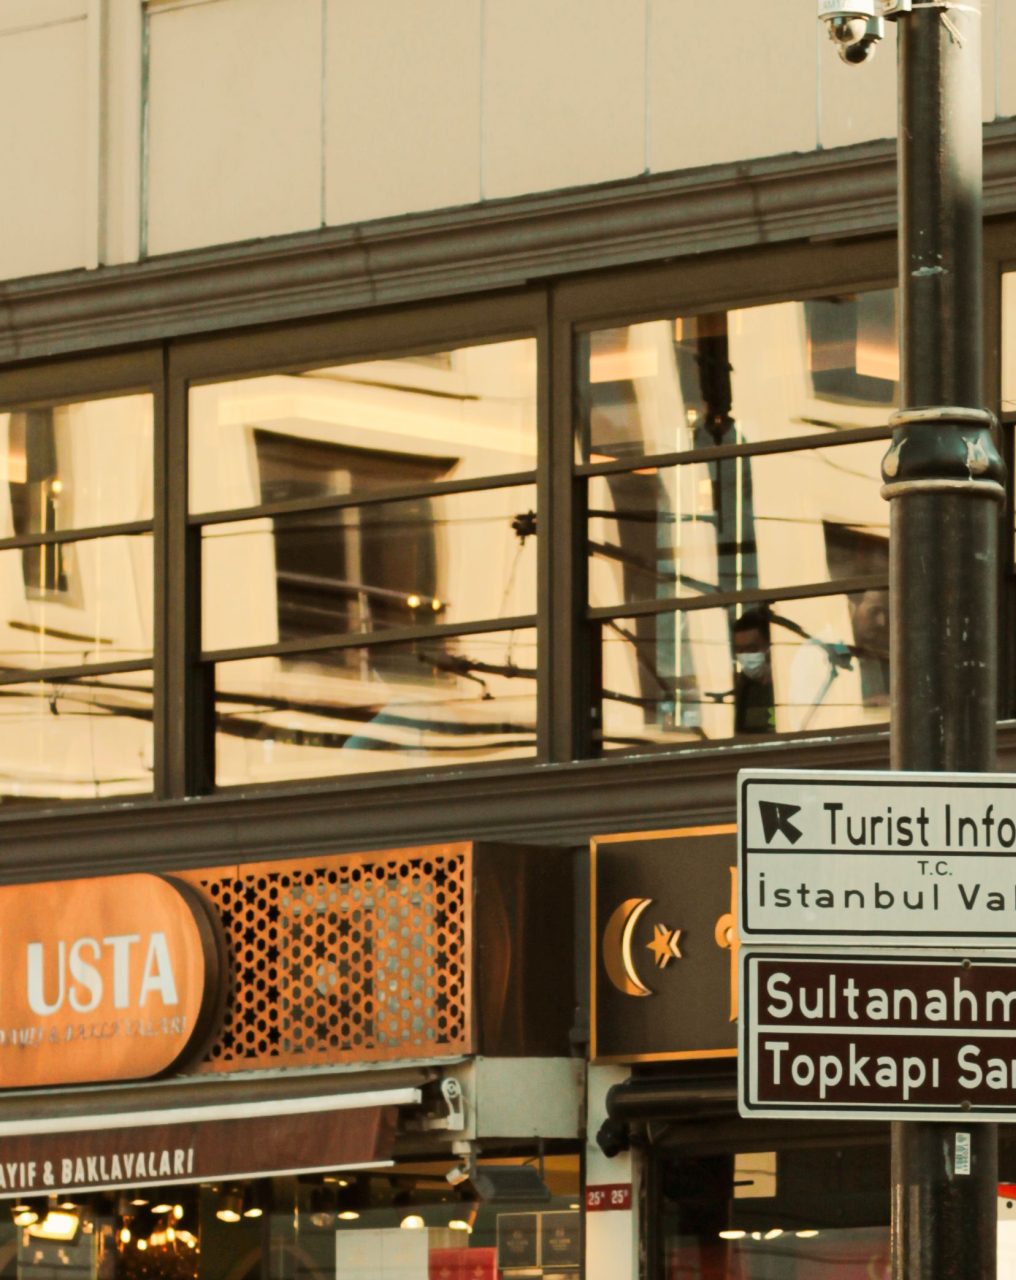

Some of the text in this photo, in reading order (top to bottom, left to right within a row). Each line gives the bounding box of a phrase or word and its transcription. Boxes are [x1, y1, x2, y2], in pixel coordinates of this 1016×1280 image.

[823, 803, 930, 847] Turist
[917, 860, 953, 876] T.C.
[758, 873, 939, 910] İstanbul
[26, 932, 178, 1017] USTA
[765, 1041, 940, 1101] Topkapı
[43, 1161, 55, 1185] &
[61, 1148, 194, 1184] BAKLAVALARI
